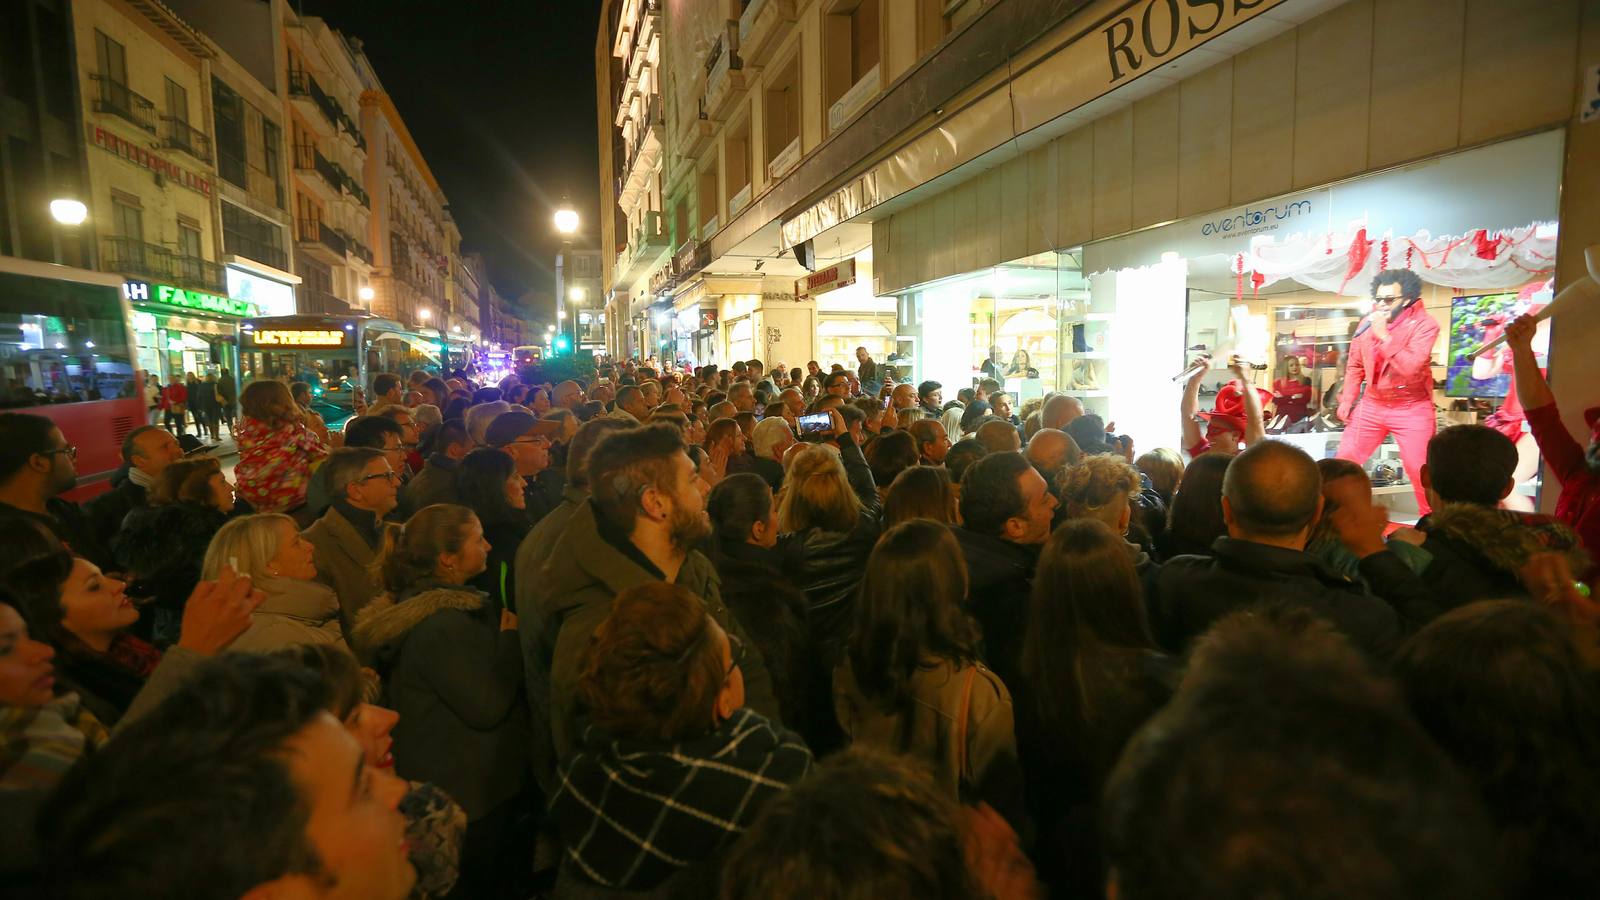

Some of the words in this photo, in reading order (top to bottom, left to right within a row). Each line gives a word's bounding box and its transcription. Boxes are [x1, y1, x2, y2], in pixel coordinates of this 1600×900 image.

[1201, 200, 1311, 235] eventorum
[1222, 223, 1279, 239] www.eventorum.eu
[158, 285, 258, 317] FARMACIA
